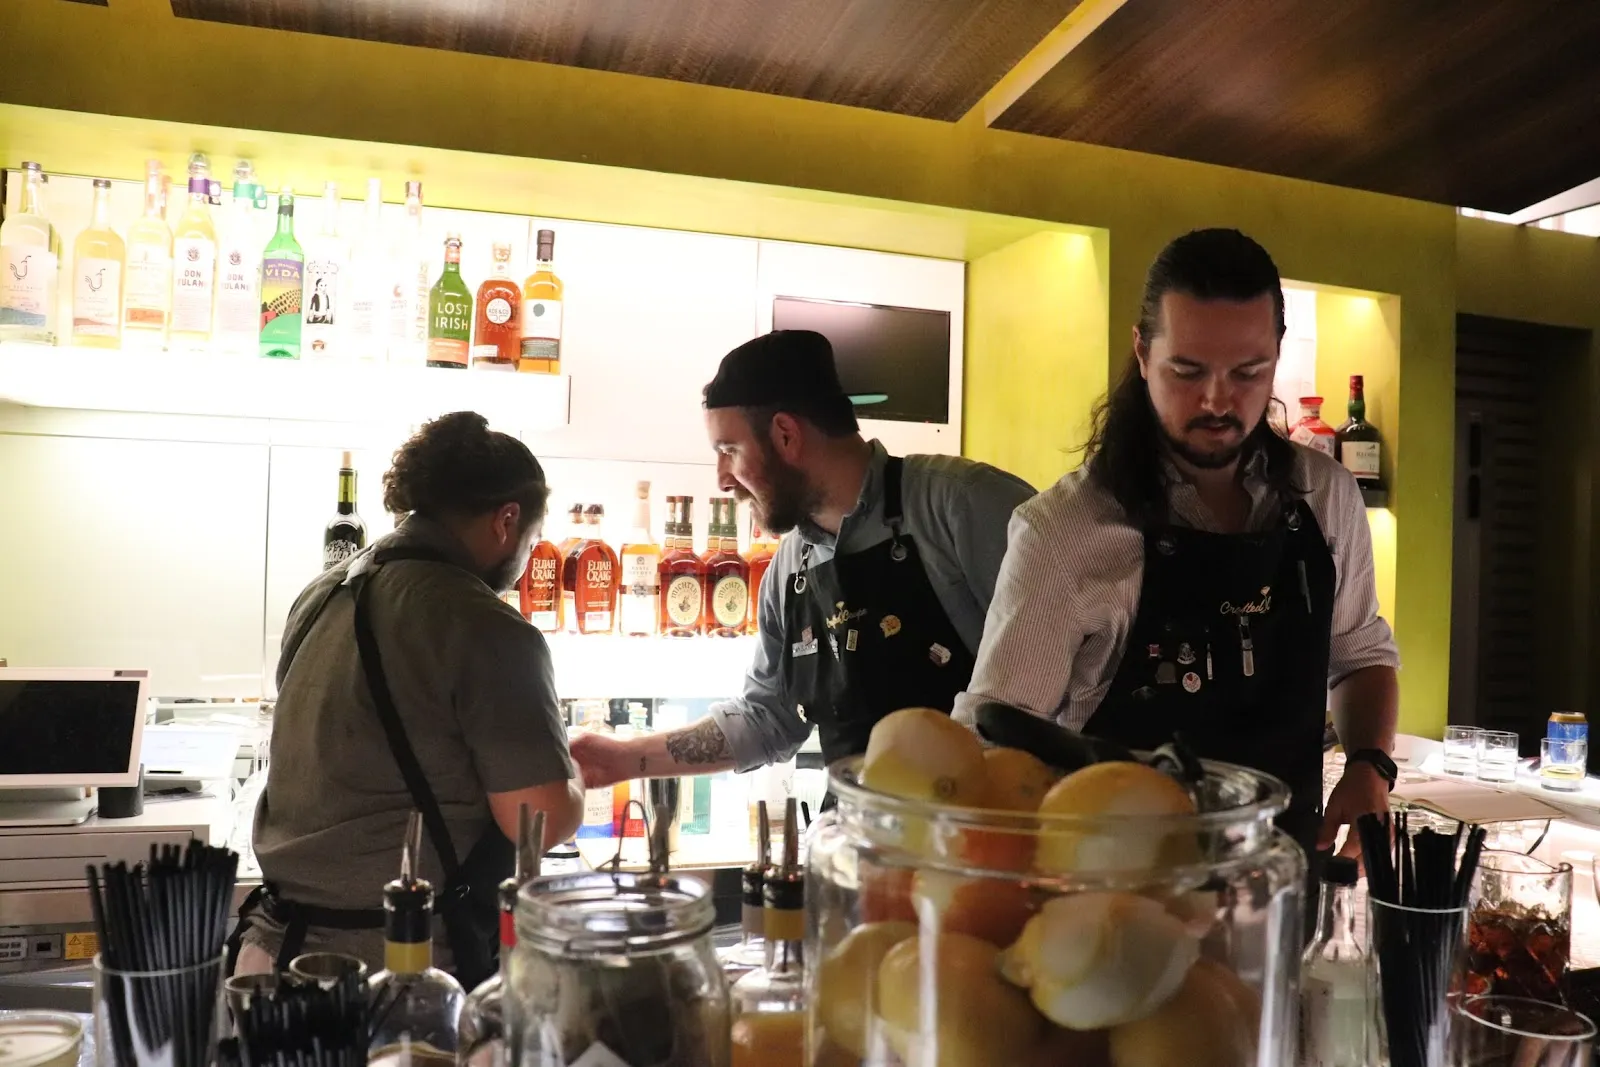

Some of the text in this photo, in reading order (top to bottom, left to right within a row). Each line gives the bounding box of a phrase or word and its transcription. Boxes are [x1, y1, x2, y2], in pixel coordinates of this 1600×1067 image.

[184, 269, 202, 278] DON
[226, 273, 244, 281] DON
[265, 269, 300, 279] VIDA
[437, 302, 469, 316] LOST
[435, 317, 469, 330] IRISH
[532, 558, 556, 569] ELIJAH
[587, 560, 611, 571] ELIJAH
[531, 569, 556, 581] CRAIG
[586, 570, 611, 582] CRAIG
[1219, 598, 1266, 615] Crafted
